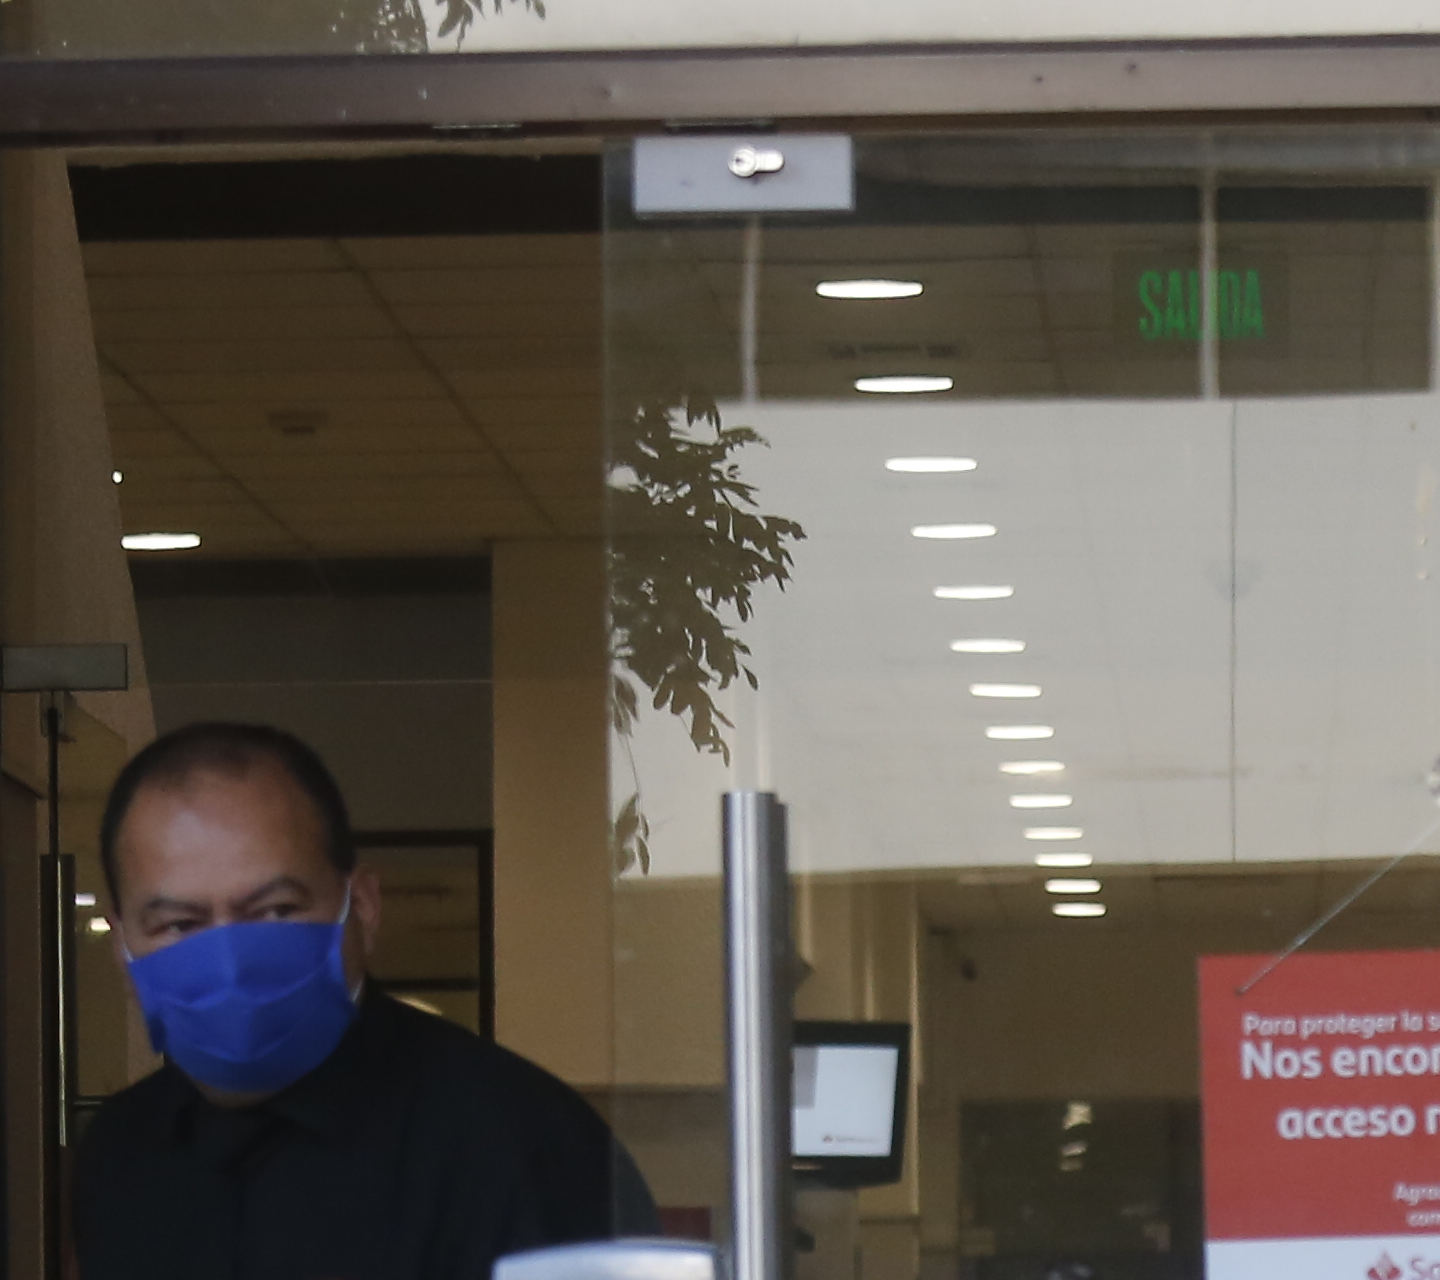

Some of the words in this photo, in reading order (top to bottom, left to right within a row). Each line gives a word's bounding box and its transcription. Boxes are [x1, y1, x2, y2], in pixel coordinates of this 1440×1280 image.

[1242, 1011, 1296, 1036] Para
[1300, 1013, 1397, 1039] proteger
[1402, 1011, 1422, 1033] la
[1241, 1039, 1322, 1079] Nos
[1277, 1102, 1416, 1139] acceso
